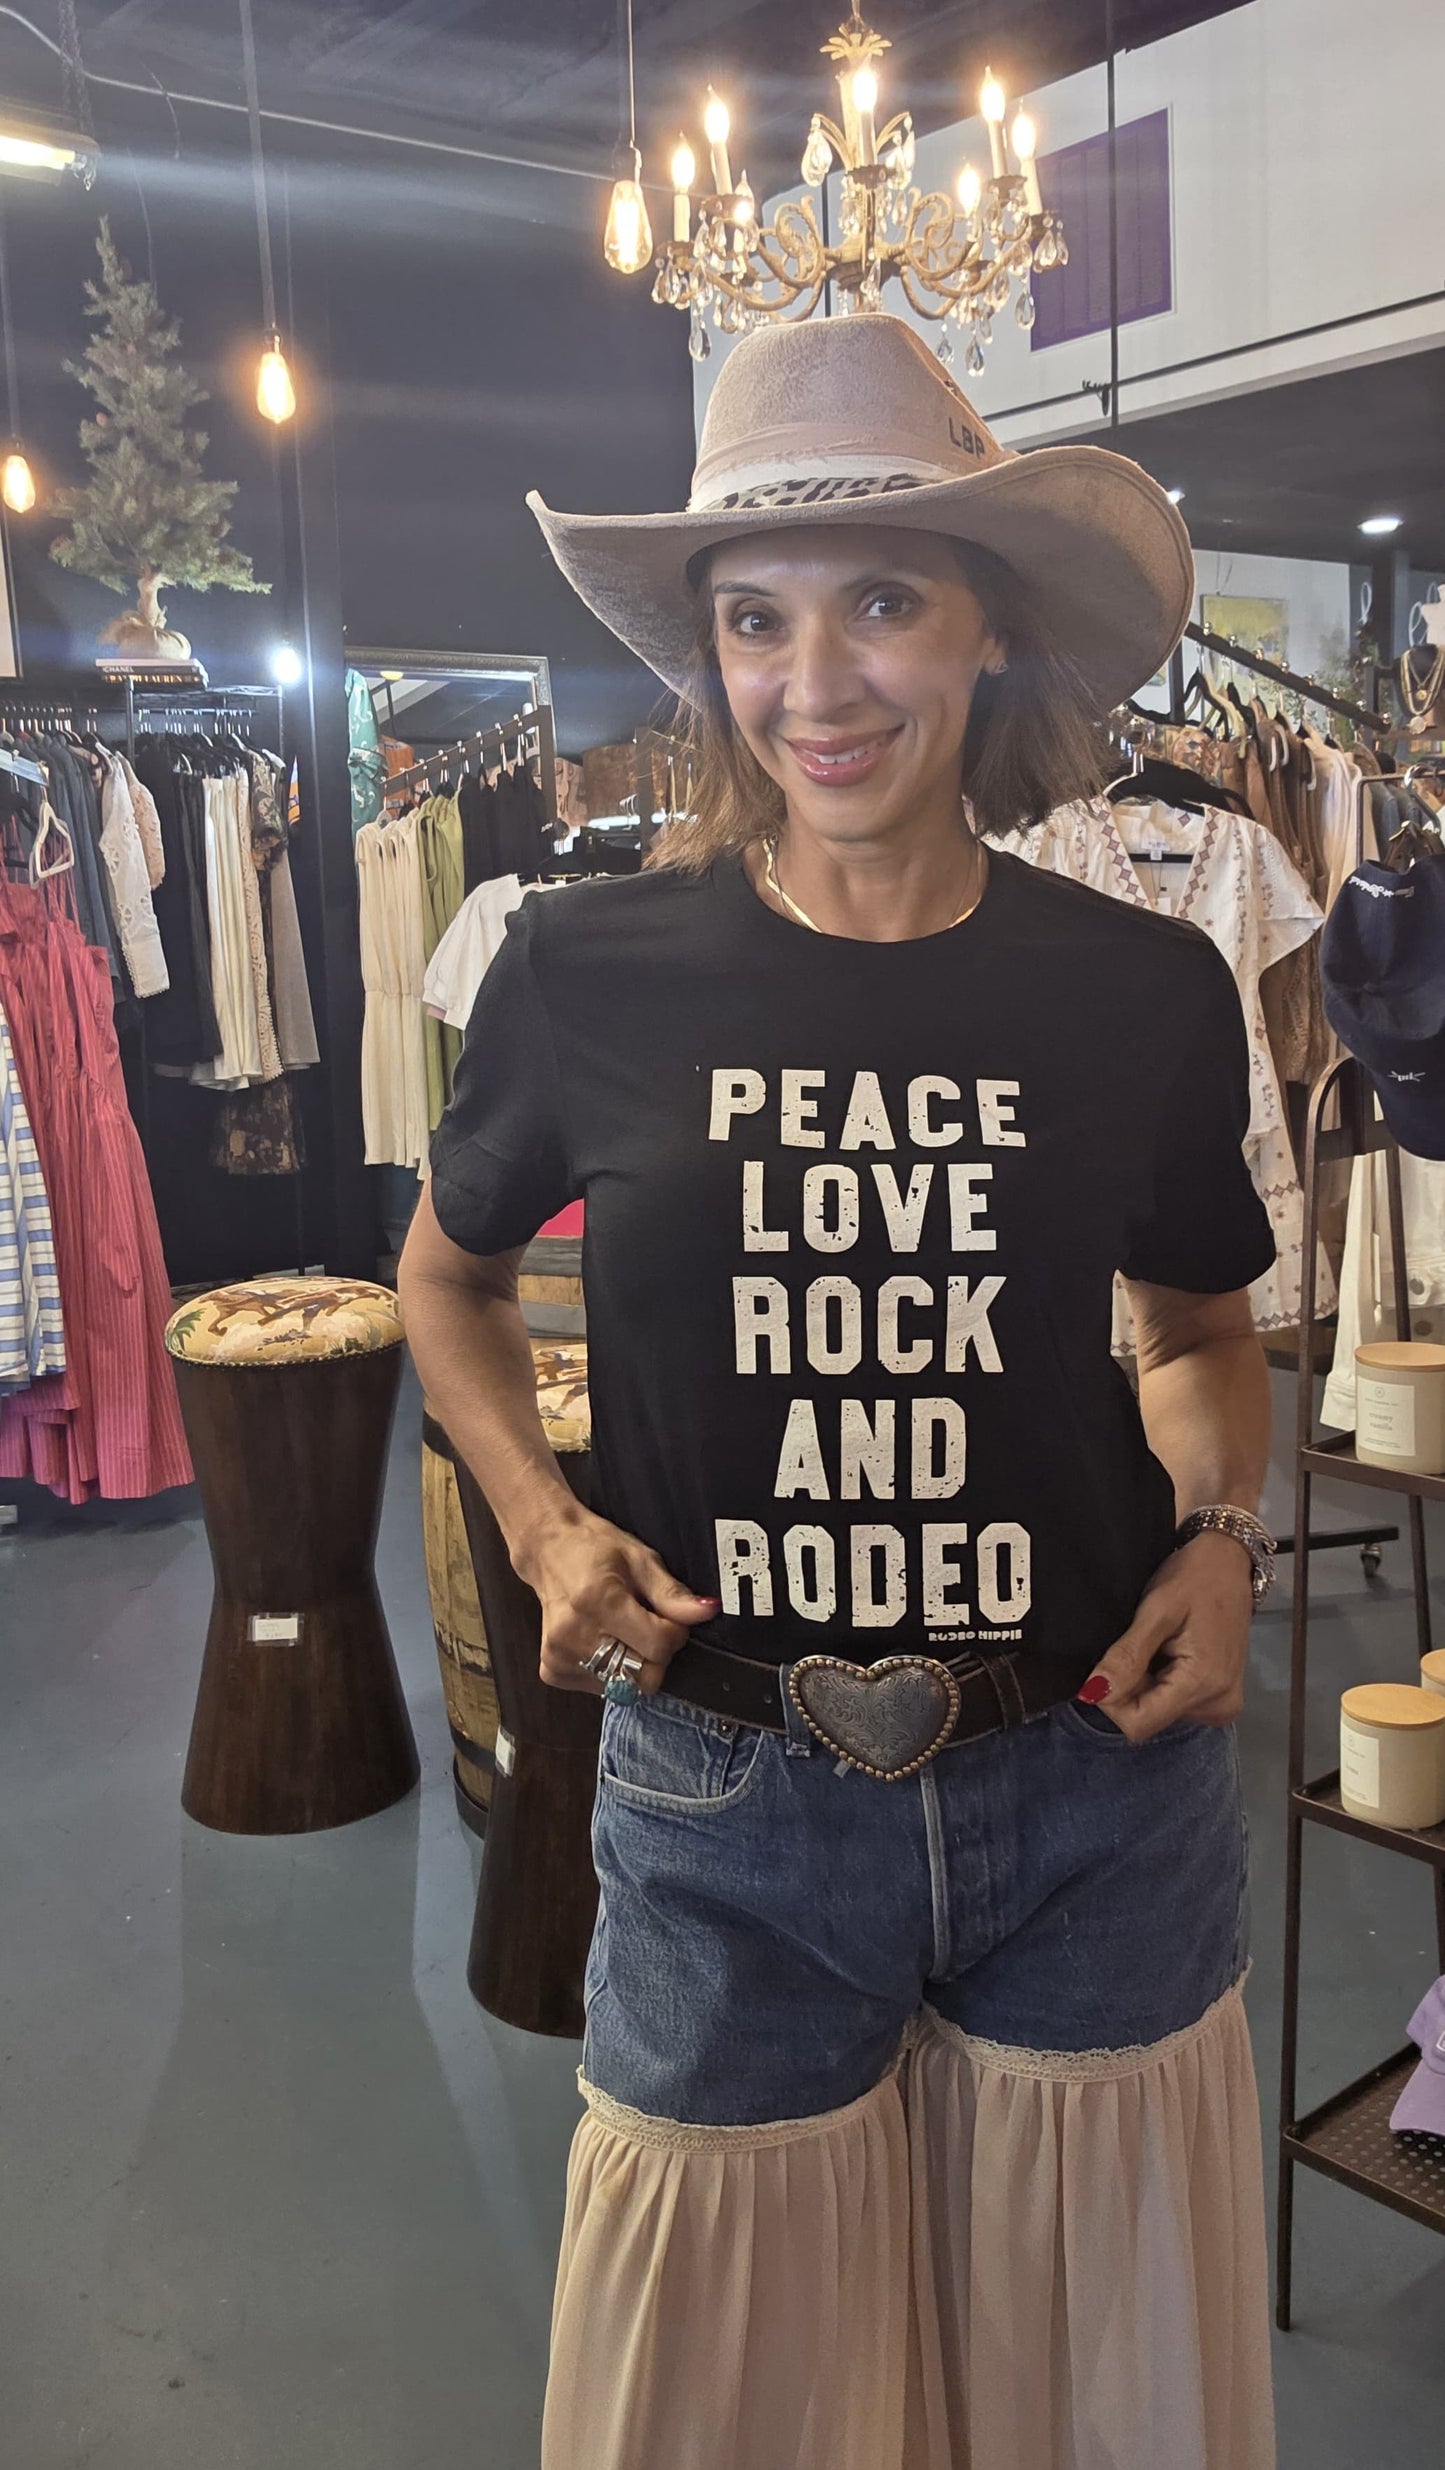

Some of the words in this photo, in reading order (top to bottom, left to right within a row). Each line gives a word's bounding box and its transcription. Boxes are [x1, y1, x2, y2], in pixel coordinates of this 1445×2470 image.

[948, 416, 985, 459] LBP
[106, 673, 142, 683] RAH
[708, 1068, 1027, 1151] PEACE
[742, 1160, 998, 1254] LOVE
[732, 1275, 1008, 1375] ROCK
[773, 1396, 968, 1501] AND
[714, 1518, 1033, 1628] RODEO
[928, 1630, 976, 1642] RODEO
[977, 1628, 1023, 1641] HIPPIE
